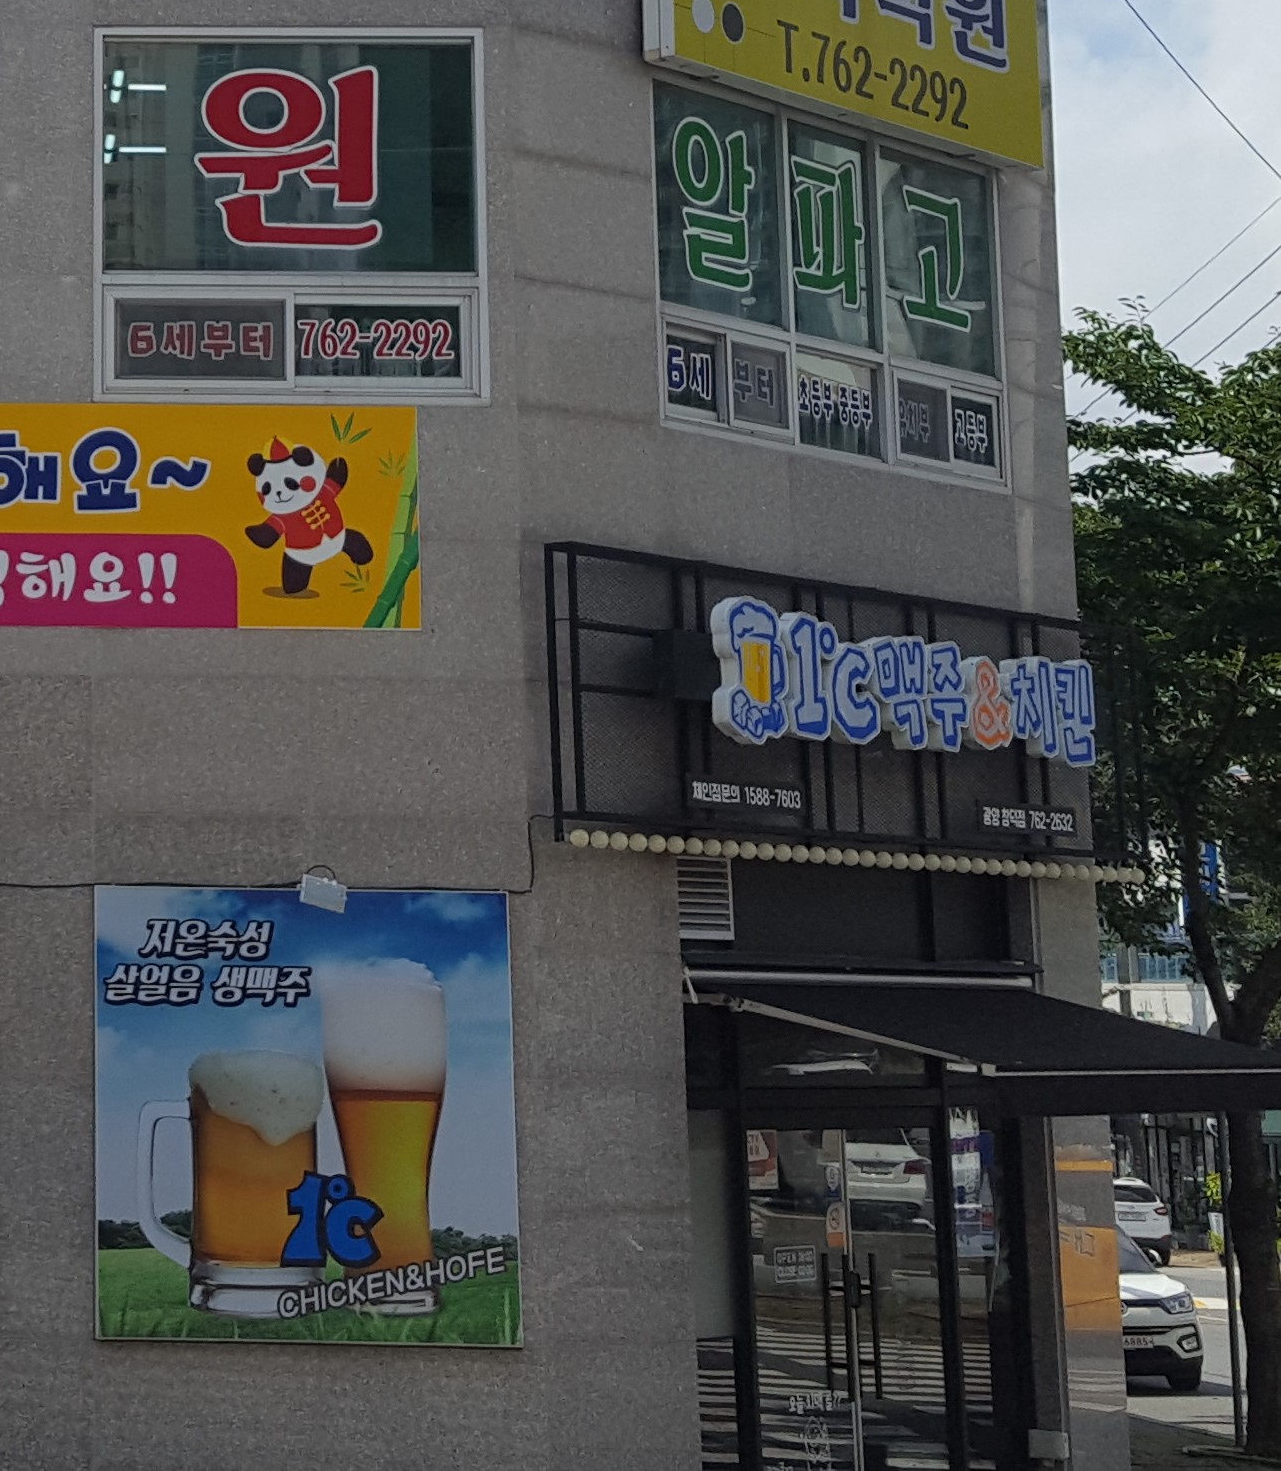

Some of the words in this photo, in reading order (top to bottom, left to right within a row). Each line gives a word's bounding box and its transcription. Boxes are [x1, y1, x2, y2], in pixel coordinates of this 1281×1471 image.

[776, 18, 969, 130] T.762-2292
[672, 116, 972, 333] 알파고
[126, 320, 274, 362] 6세부터
[298, 318, 455, 361] 762-2292
[797, 373, 835, 421] 초등부
[839, 383, 874, 428] 중등부
[954, 408, 988, 454] 고등부
[744, 786, 801, 809] 1588-7603
[138, 918, 275, 960] 저온숙성
[103, 962, 202, 1006] 살얼음
[211, 964, 312, 1007] 생맥주
[276, 1246, 507, 1320] CHICKEN&HOFE
